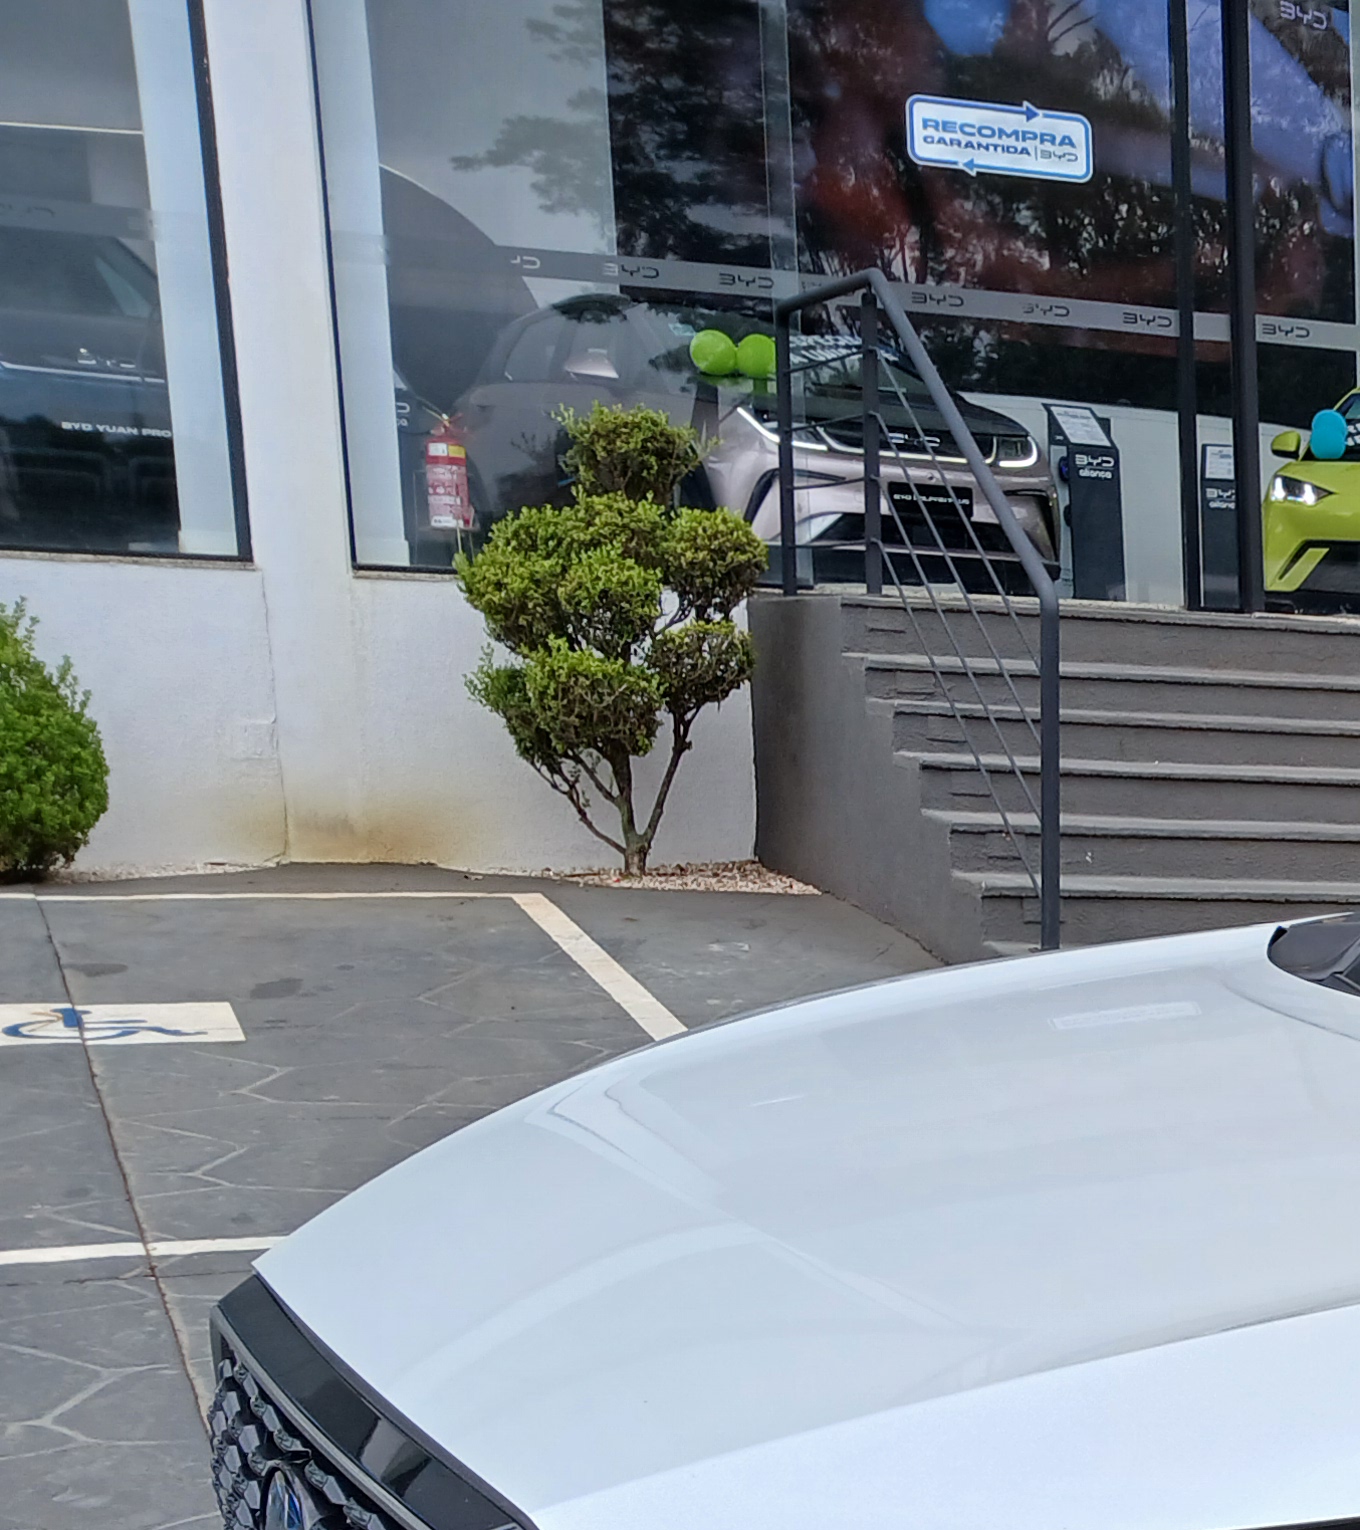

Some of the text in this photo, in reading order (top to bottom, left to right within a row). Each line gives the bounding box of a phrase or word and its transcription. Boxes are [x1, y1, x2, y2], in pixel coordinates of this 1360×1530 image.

[1280, 1, 1328, 30] BYD
[922, 117, 1077, 149] RECOMPRA
[923, 135, 1079, 163] GARANTIDA BYD
[718, 272, 775, 290] BYD
[911, 291, 965, 307] BYD
[1122, 311, 1173, 328] BYD
[1261, 322, 1311, 339] BYD
[61, 421, 173, 438] BYD YUAN PRO
[1074, 453, 1115, 468] BYD
